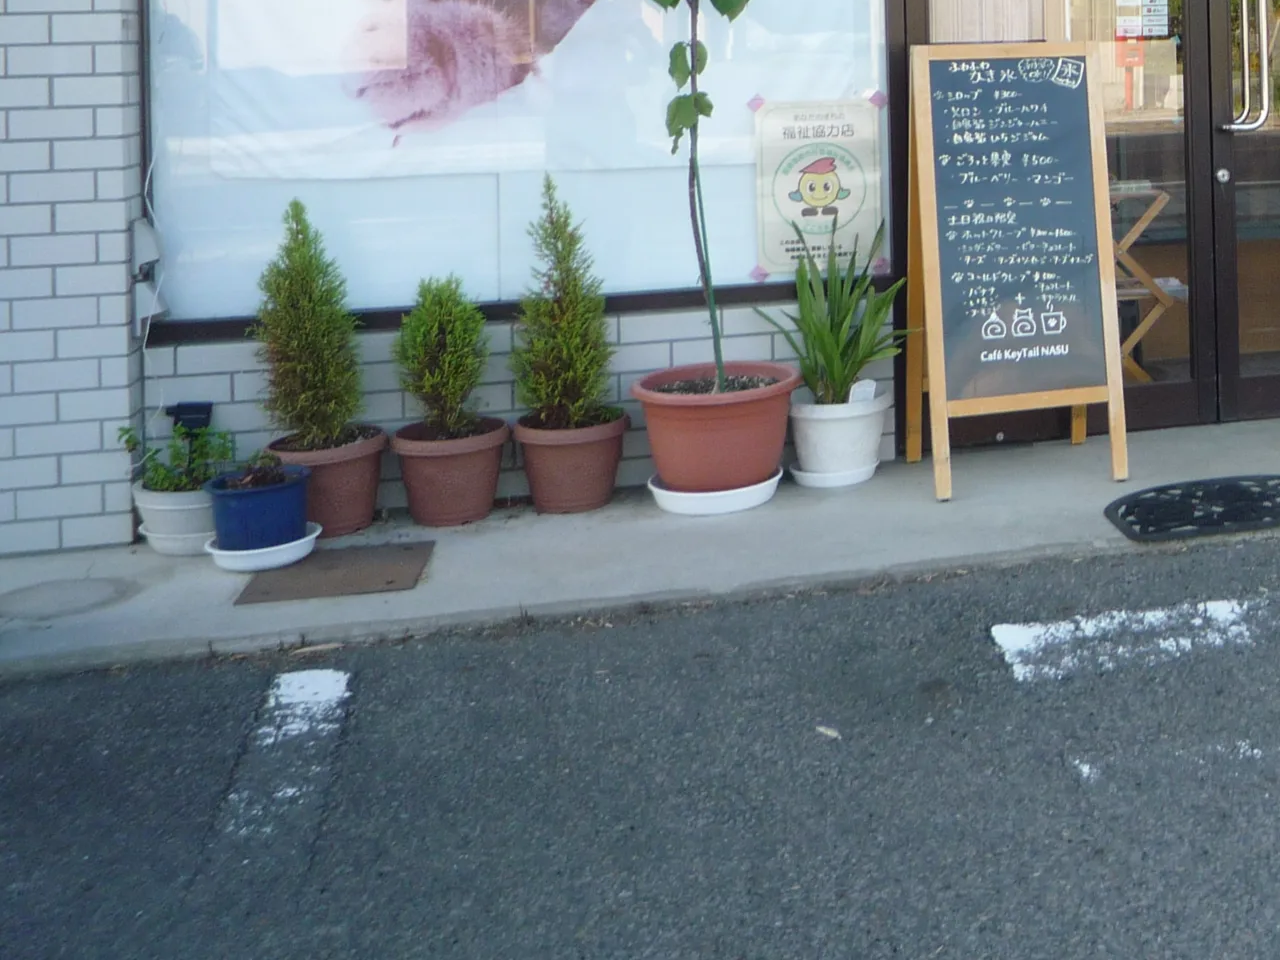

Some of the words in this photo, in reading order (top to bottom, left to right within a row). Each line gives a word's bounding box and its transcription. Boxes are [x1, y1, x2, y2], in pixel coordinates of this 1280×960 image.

[782, 123, 855, 140] 福祉協力店
[980, 349, 1003, 362] Café
[1003, 346, 1040, 363] KeyTail
[1041, 344, 1070, 357] NASU
